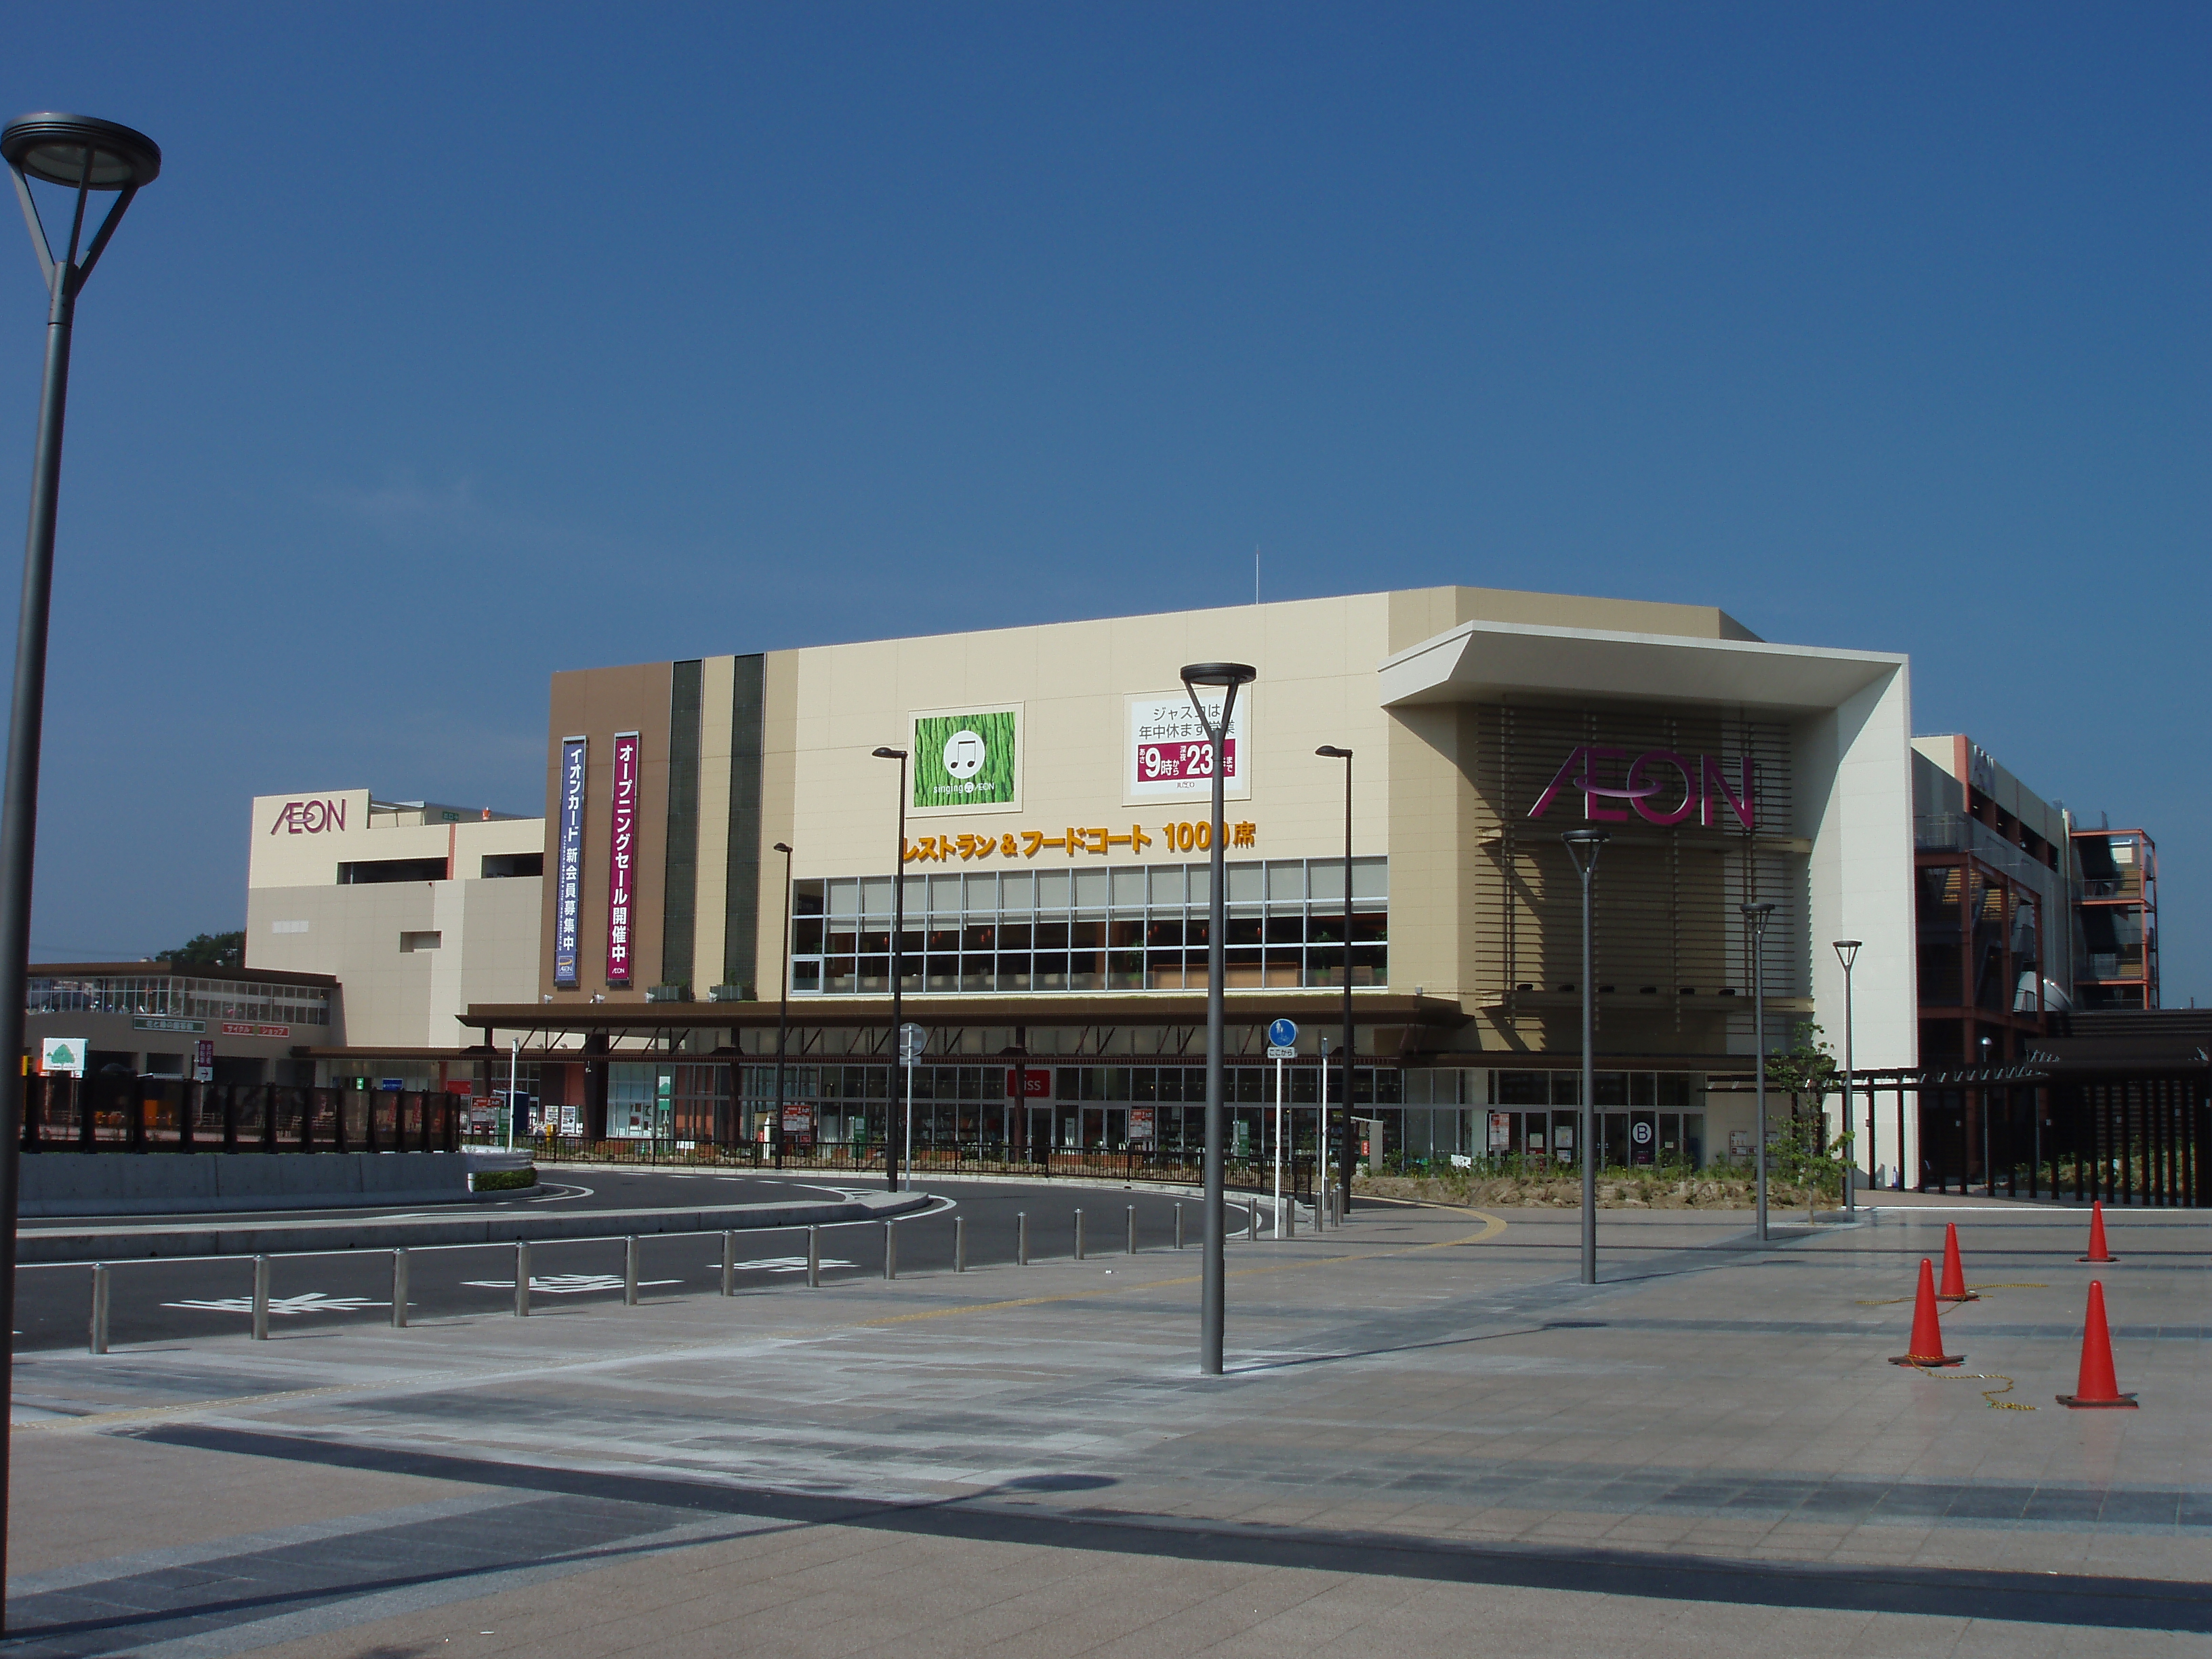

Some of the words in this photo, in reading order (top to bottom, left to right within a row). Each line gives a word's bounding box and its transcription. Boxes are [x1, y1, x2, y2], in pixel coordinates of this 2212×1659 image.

[933, 783, 963, 795] singing
[612, 745, 634, 962] オープニングセール開催中
[1023, 1075, 1042, 1091] iss
[1637, 1125, 1648, 1141] B
